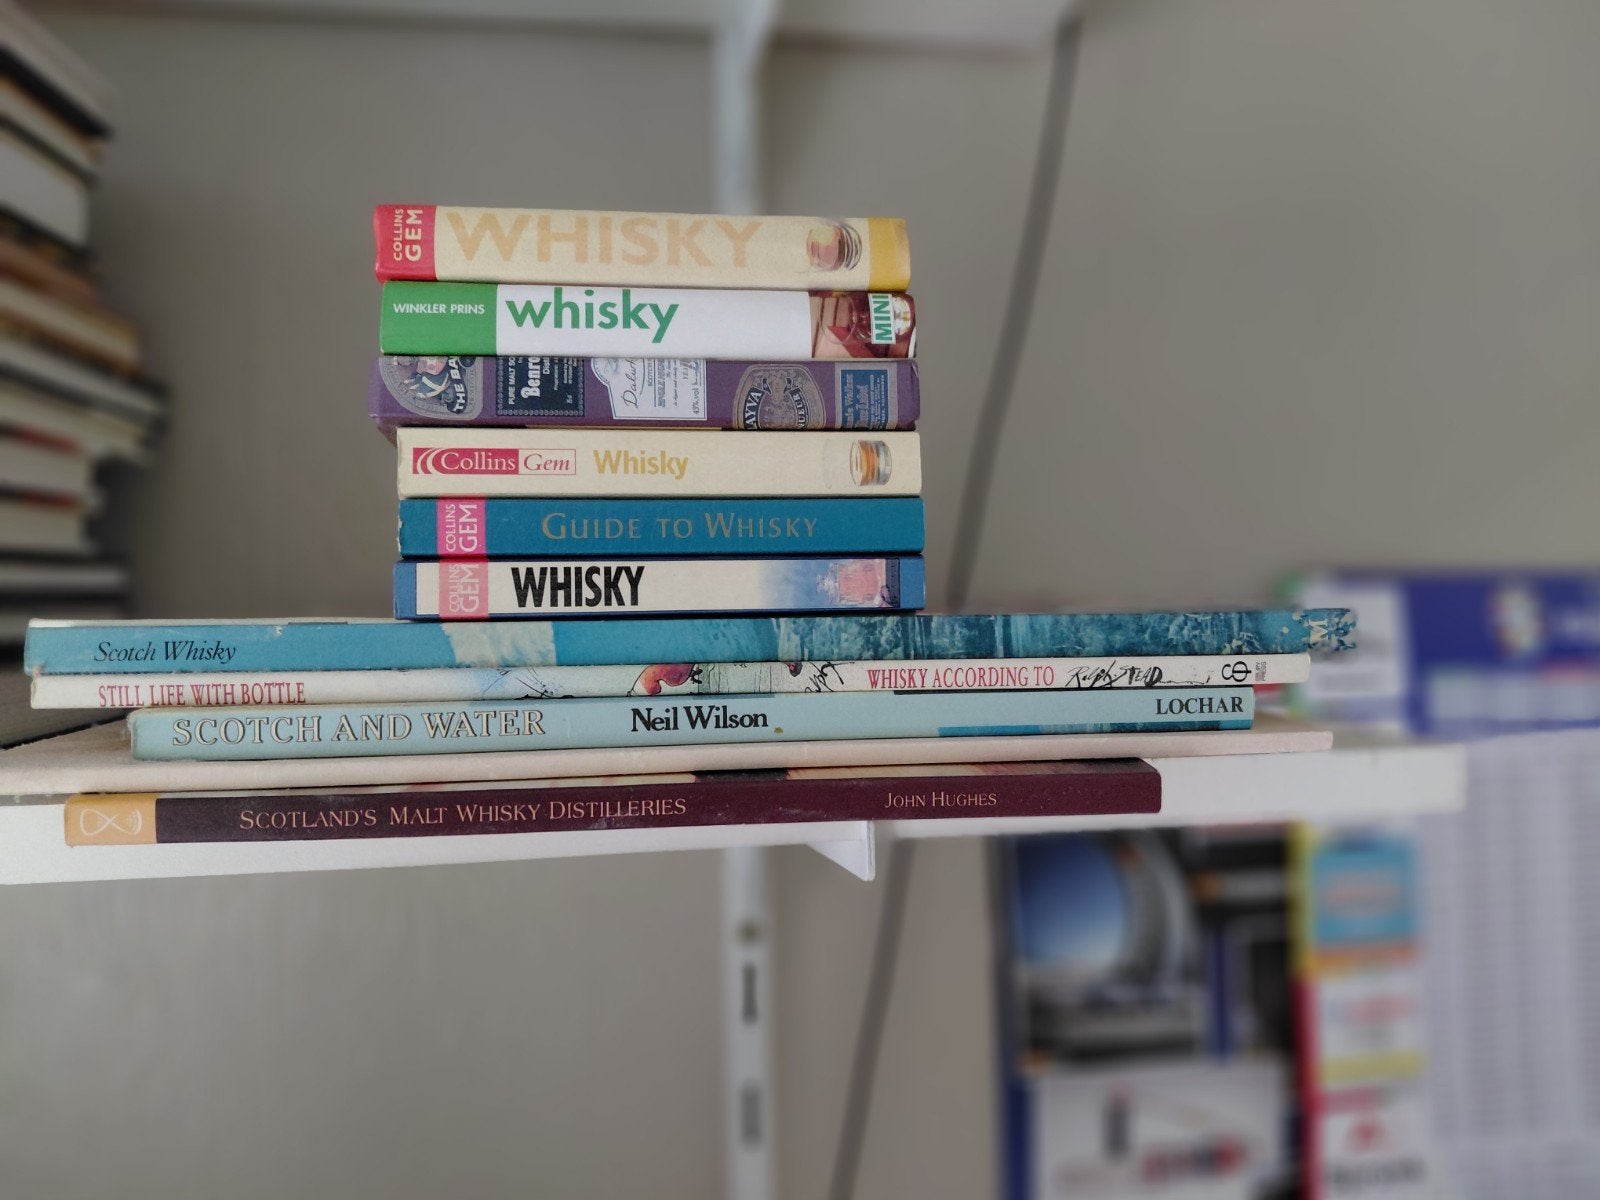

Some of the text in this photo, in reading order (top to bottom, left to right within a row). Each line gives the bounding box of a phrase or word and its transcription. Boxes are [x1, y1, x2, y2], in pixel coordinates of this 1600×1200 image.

[393, 208, 404, 261] COLLINS
[404, 208, 423, 262] GEM
[446, 211, 763, 268] WHISKY
[393, 303, 485, 315] WINKLER PRINS
[505, 286, 680, 344] whisky
[872, 294, 892, 341] MINI
[508, 367, 516, 385] MALT
[452, 383, 466, 412] THE
[508, 386, 516, 405] PURE
[441, 451, 570, 471] Collins Gem
[593, 449, 689, 480] Whisky
[445, 503, 457, 552] COLLINS
[459, 503, 477, 552] GEM
[541, 512, 818, 540] GUIDE TO WHISKY
[449, 563, 462, 612] COLLINS
[459, 562, 480, 613] GEM
[511, 565, 645, 608] WHISKY
[94, 640, 236, 664] Scotch Whisky
[867, 668, 928, 689] WHISKY
[932, 666, 1029, 688] ACCORDING
[1033, 665, 1054, 686] TO
[98, 681, 306, 707] STILL LIFE WITH BOTTLE
[1155, 696, 1244, 716] LOCHAR
[172, 709, 546, 747] SCOTCH AND WATER
[631, 704, 768, 733] Neil Wilson
[239, 798, 686, 830] SCOTLAND'S MALT WHISKY DISTILLERIES
[885, 791, 997, 808] JOHN HUGHES
